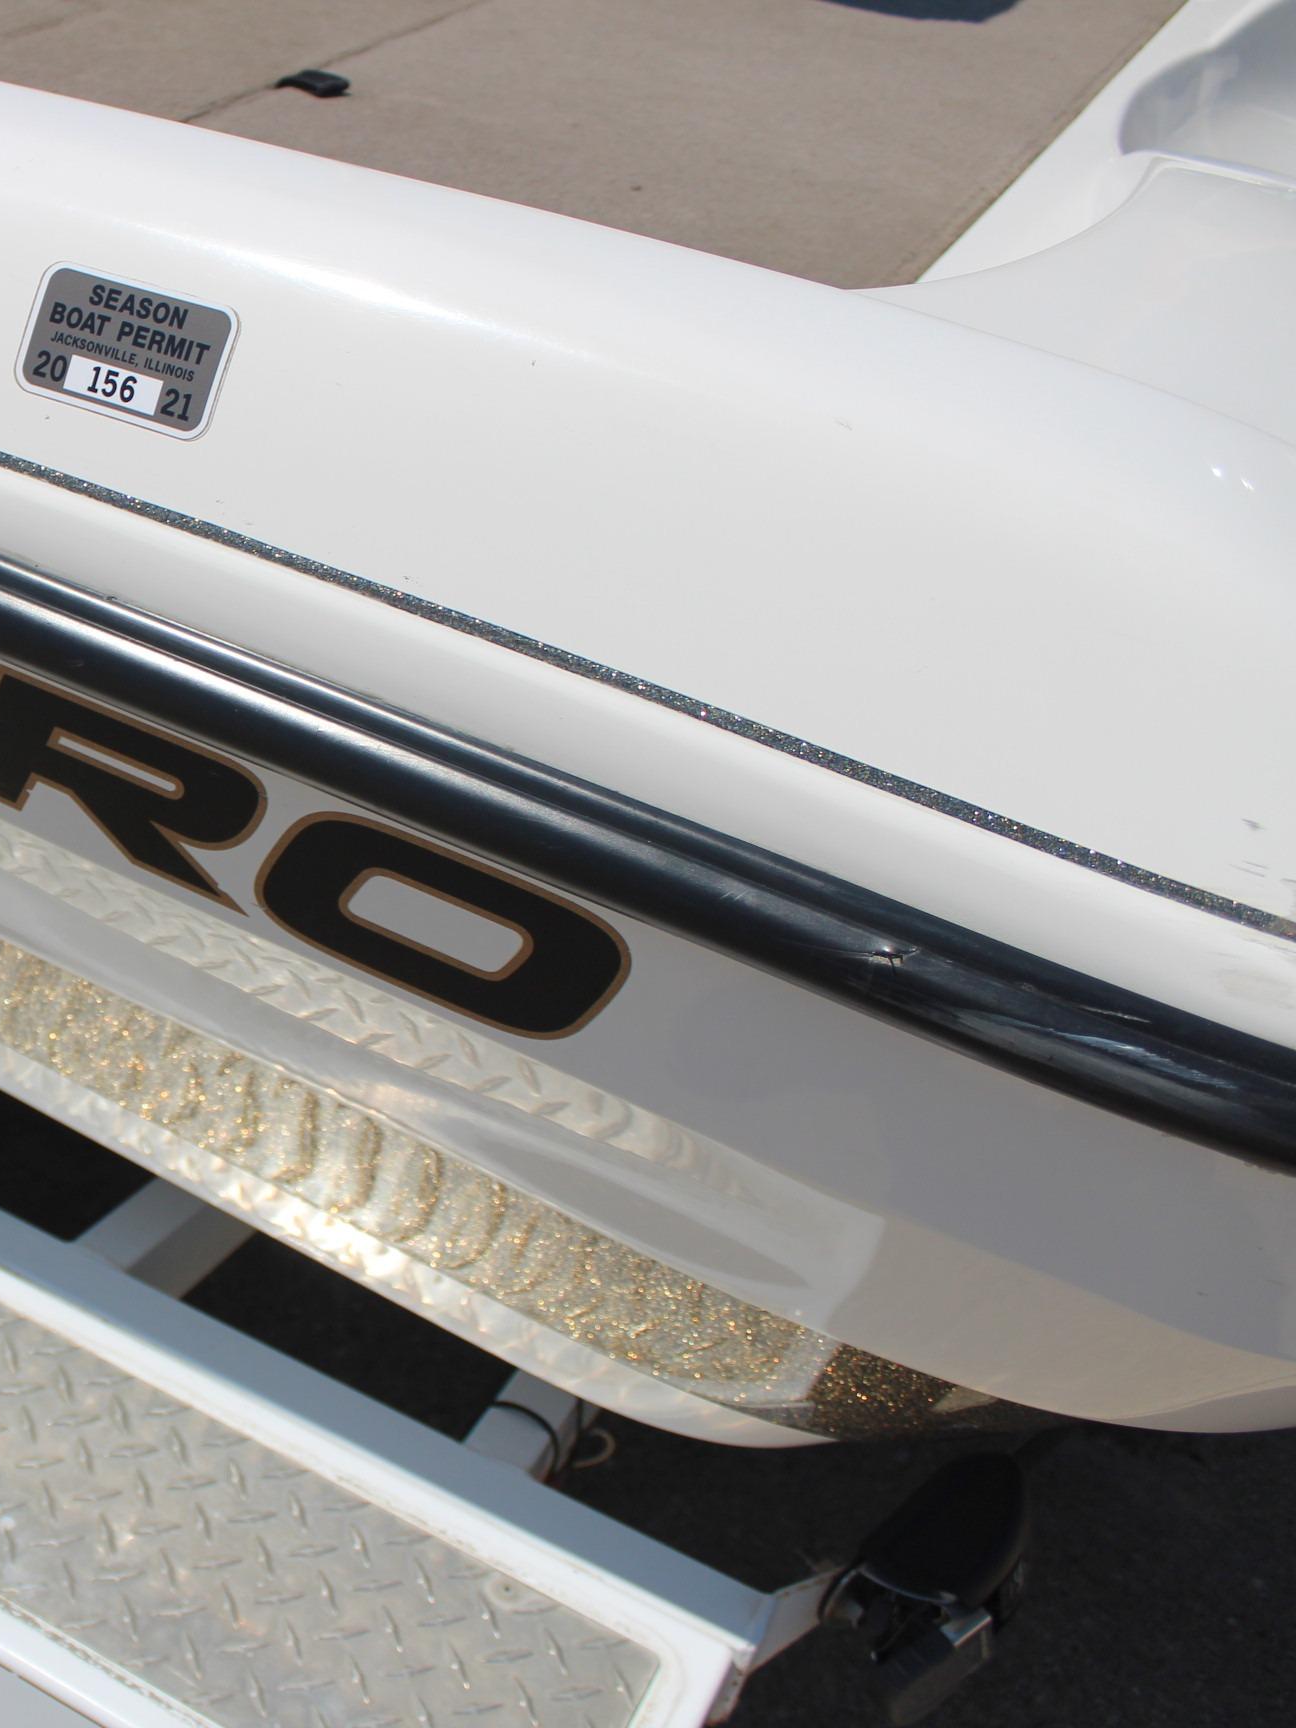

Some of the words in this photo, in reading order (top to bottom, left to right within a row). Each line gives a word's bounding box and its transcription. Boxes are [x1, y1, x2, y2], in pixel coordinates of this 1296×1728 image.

[49, 302, 111, 337] BOAT
[116, 320, 211, 366] PERMIT
[89, 284, 189, 330] SEASON
[50, 331, 139, 368] JACKSONVILLE,
[143, 358, 195, 382] ILLINOIS
[32, 350, 68, 382] 20
[87, 366, 138, 403] 156
[160, 388, 193, 422] 21
